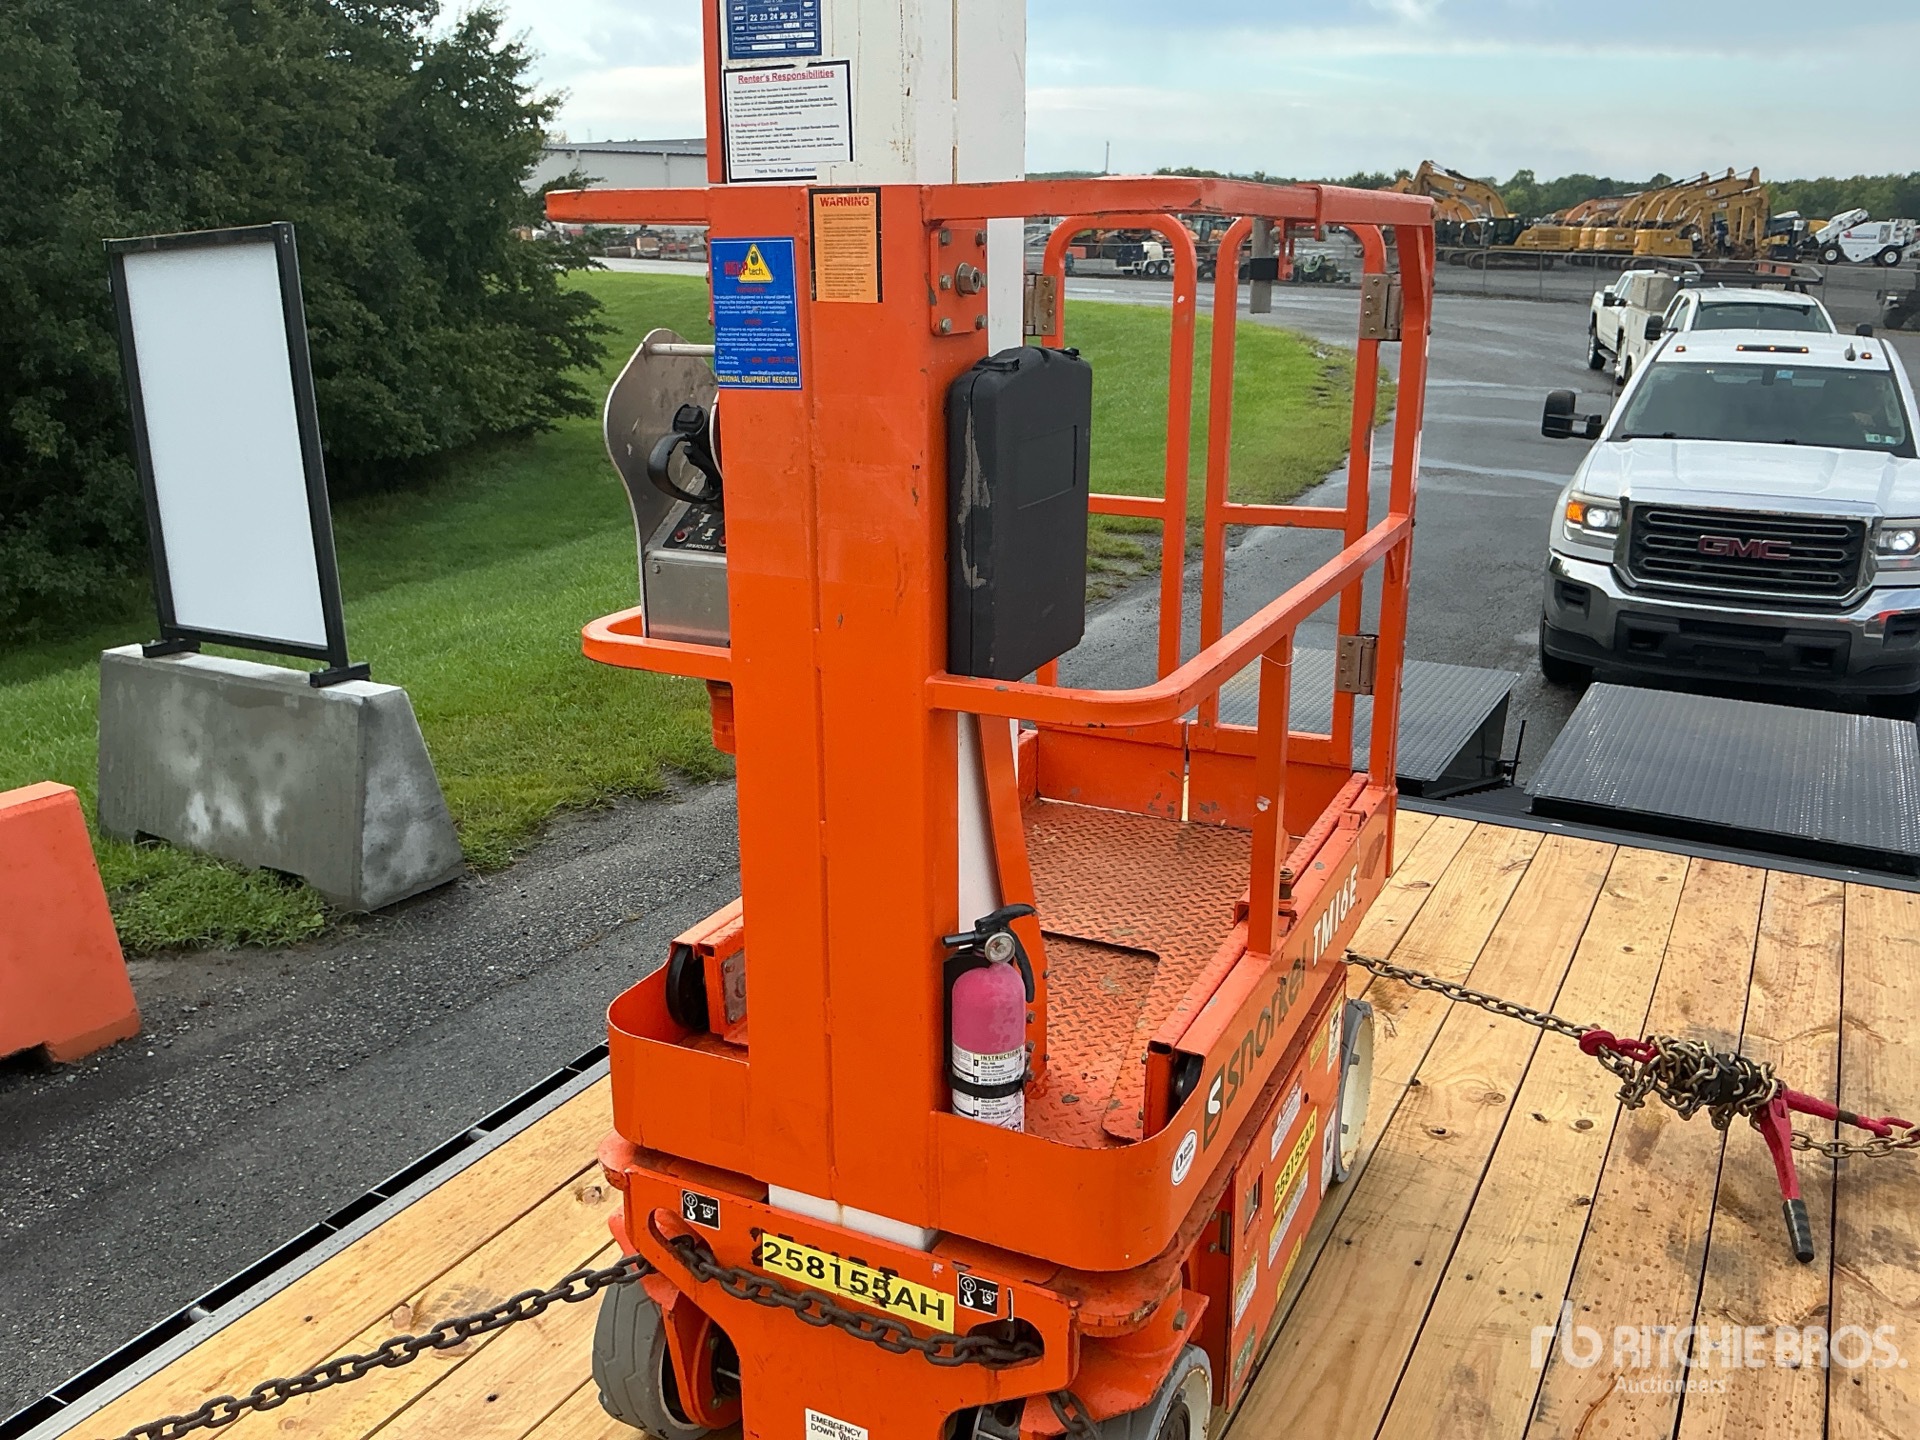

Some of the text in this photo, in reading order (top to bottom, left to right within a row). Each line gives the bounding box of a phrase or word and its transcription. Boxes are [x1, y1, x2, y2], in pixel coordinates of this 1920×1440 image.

[760, 13, 768, 21] 23
[738, 70, 835, 84] Renter's Responsibilities
[820, 196, 870, 207] WARNING
[717, 375, 798, 384] NATIONAL EQUIPMENT REGISTER
[1697, 535, 1792, 561] GMC
[1313, 863, 1358, 967] TM16E
[1226, 939, 1308, 1110] snorkel
[1274, 1112, 1316, 1204] 258155AH
[763, 1240, 945, 1322] 258155AH
[810, 1413, 862, 1437] EMERGENCY
[810, 1423, 836, 1437] DOWN
